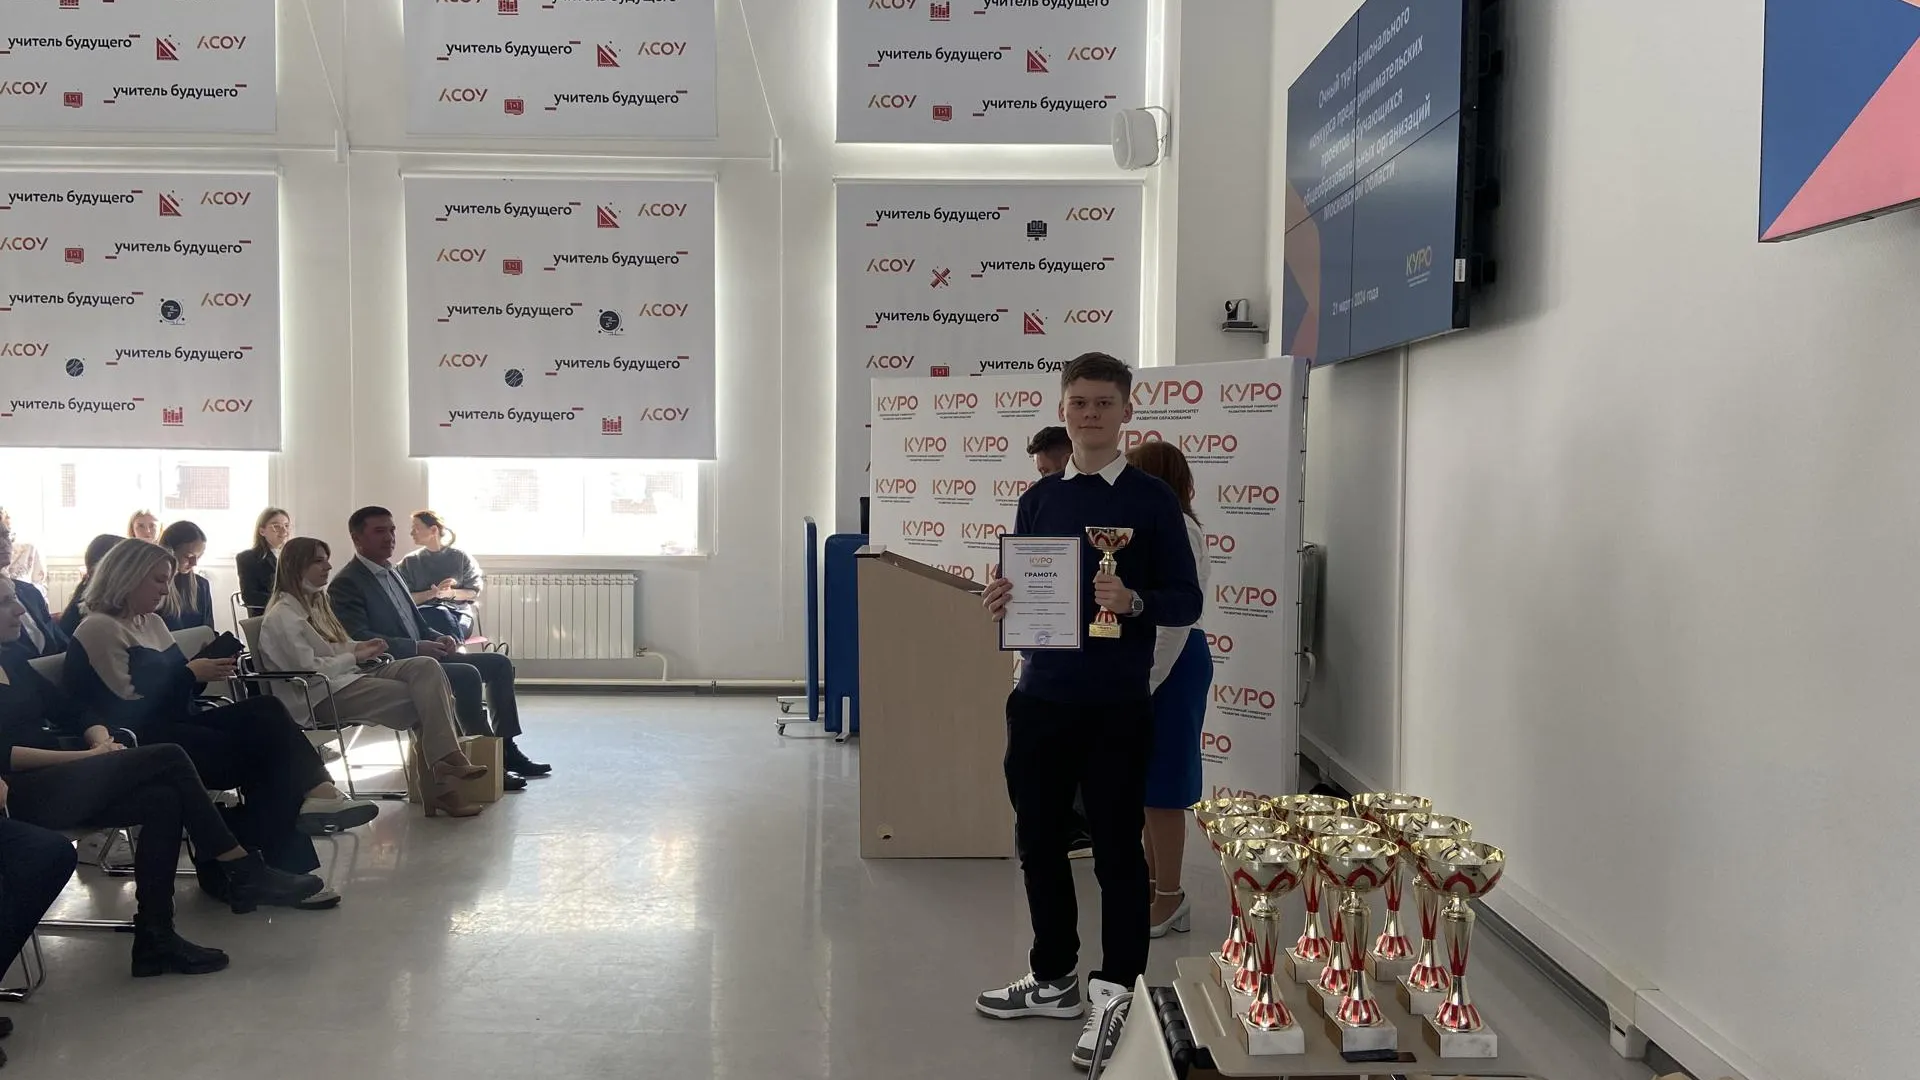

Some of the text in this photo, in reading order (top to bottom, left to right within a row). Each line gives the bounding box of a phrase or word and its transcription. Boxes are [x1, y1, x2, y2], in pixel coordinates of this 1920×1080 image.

[8, 35, 132, 50] учитель будущего
[446, 41, 572, 57] учитель будущего
[877, 47, 1002, 63] учитель будущего
[1318, 6, 1410, 109] Очный тур регионального
[113, 84, 238, 99] учитель будущего
[554, 91, 679, 106] учитель будущего
[982, 96, 1107, 112] учитель будущего
[1309, 116, 1336, 151] конкурса
[1320, 87, 1403, 170] проектов обучающихся
[1376, 94, 1431, 157] организаций
[1364, 160, 1395, 194] области
[9, 190, 135, 206] учитель будущего
[445, 203, 572, 218] учитель будущего
[876, 207, 1001, 223] учитель будущего
[115, 240, 243, 256] учитель будущего
[553, 251, 679, 267] учитель будущего
[981, 258, 1106, 273] учитель будущего
[1406, 245, 1431, 277] КУРО
[9, 292, 135, 307] учитель будущего
[447, 303, 574, 318] учитель будущего
[875, 309, 1000, 325] учитель будущего
[116, 347, 243, 362] учитель будущего
[555, 356, 681, 371] учитель будущего
[980, 361, 1034, 372] учитель
[996, 391, 1042, 408] КУРО
[1221, 383, 1281, 402] КУРО
[10, 398, 136, 413] учитель будущего
[878, 396, 918, 411] КУРО
[935, 393, 978, 409] КУРО
[449, 407, 575, 423] учитель будущего
[905, 437, 946, 452] КУРО
[964, 436, 1008, 452] КУРО
[1179, 434, 1237, 452] КУРО
[876, 479, 916, 493] КУРО
[933, 480, 976, 495] КУРО
[994, 480, 1037, 496] КУР
[1219, 485, 1279, 504] КУРО
[903, 521, 944, 536] КУРО
[1215, 584, 1277, 607] КУРО
[1213, 684, 1276, 709] КУРО
